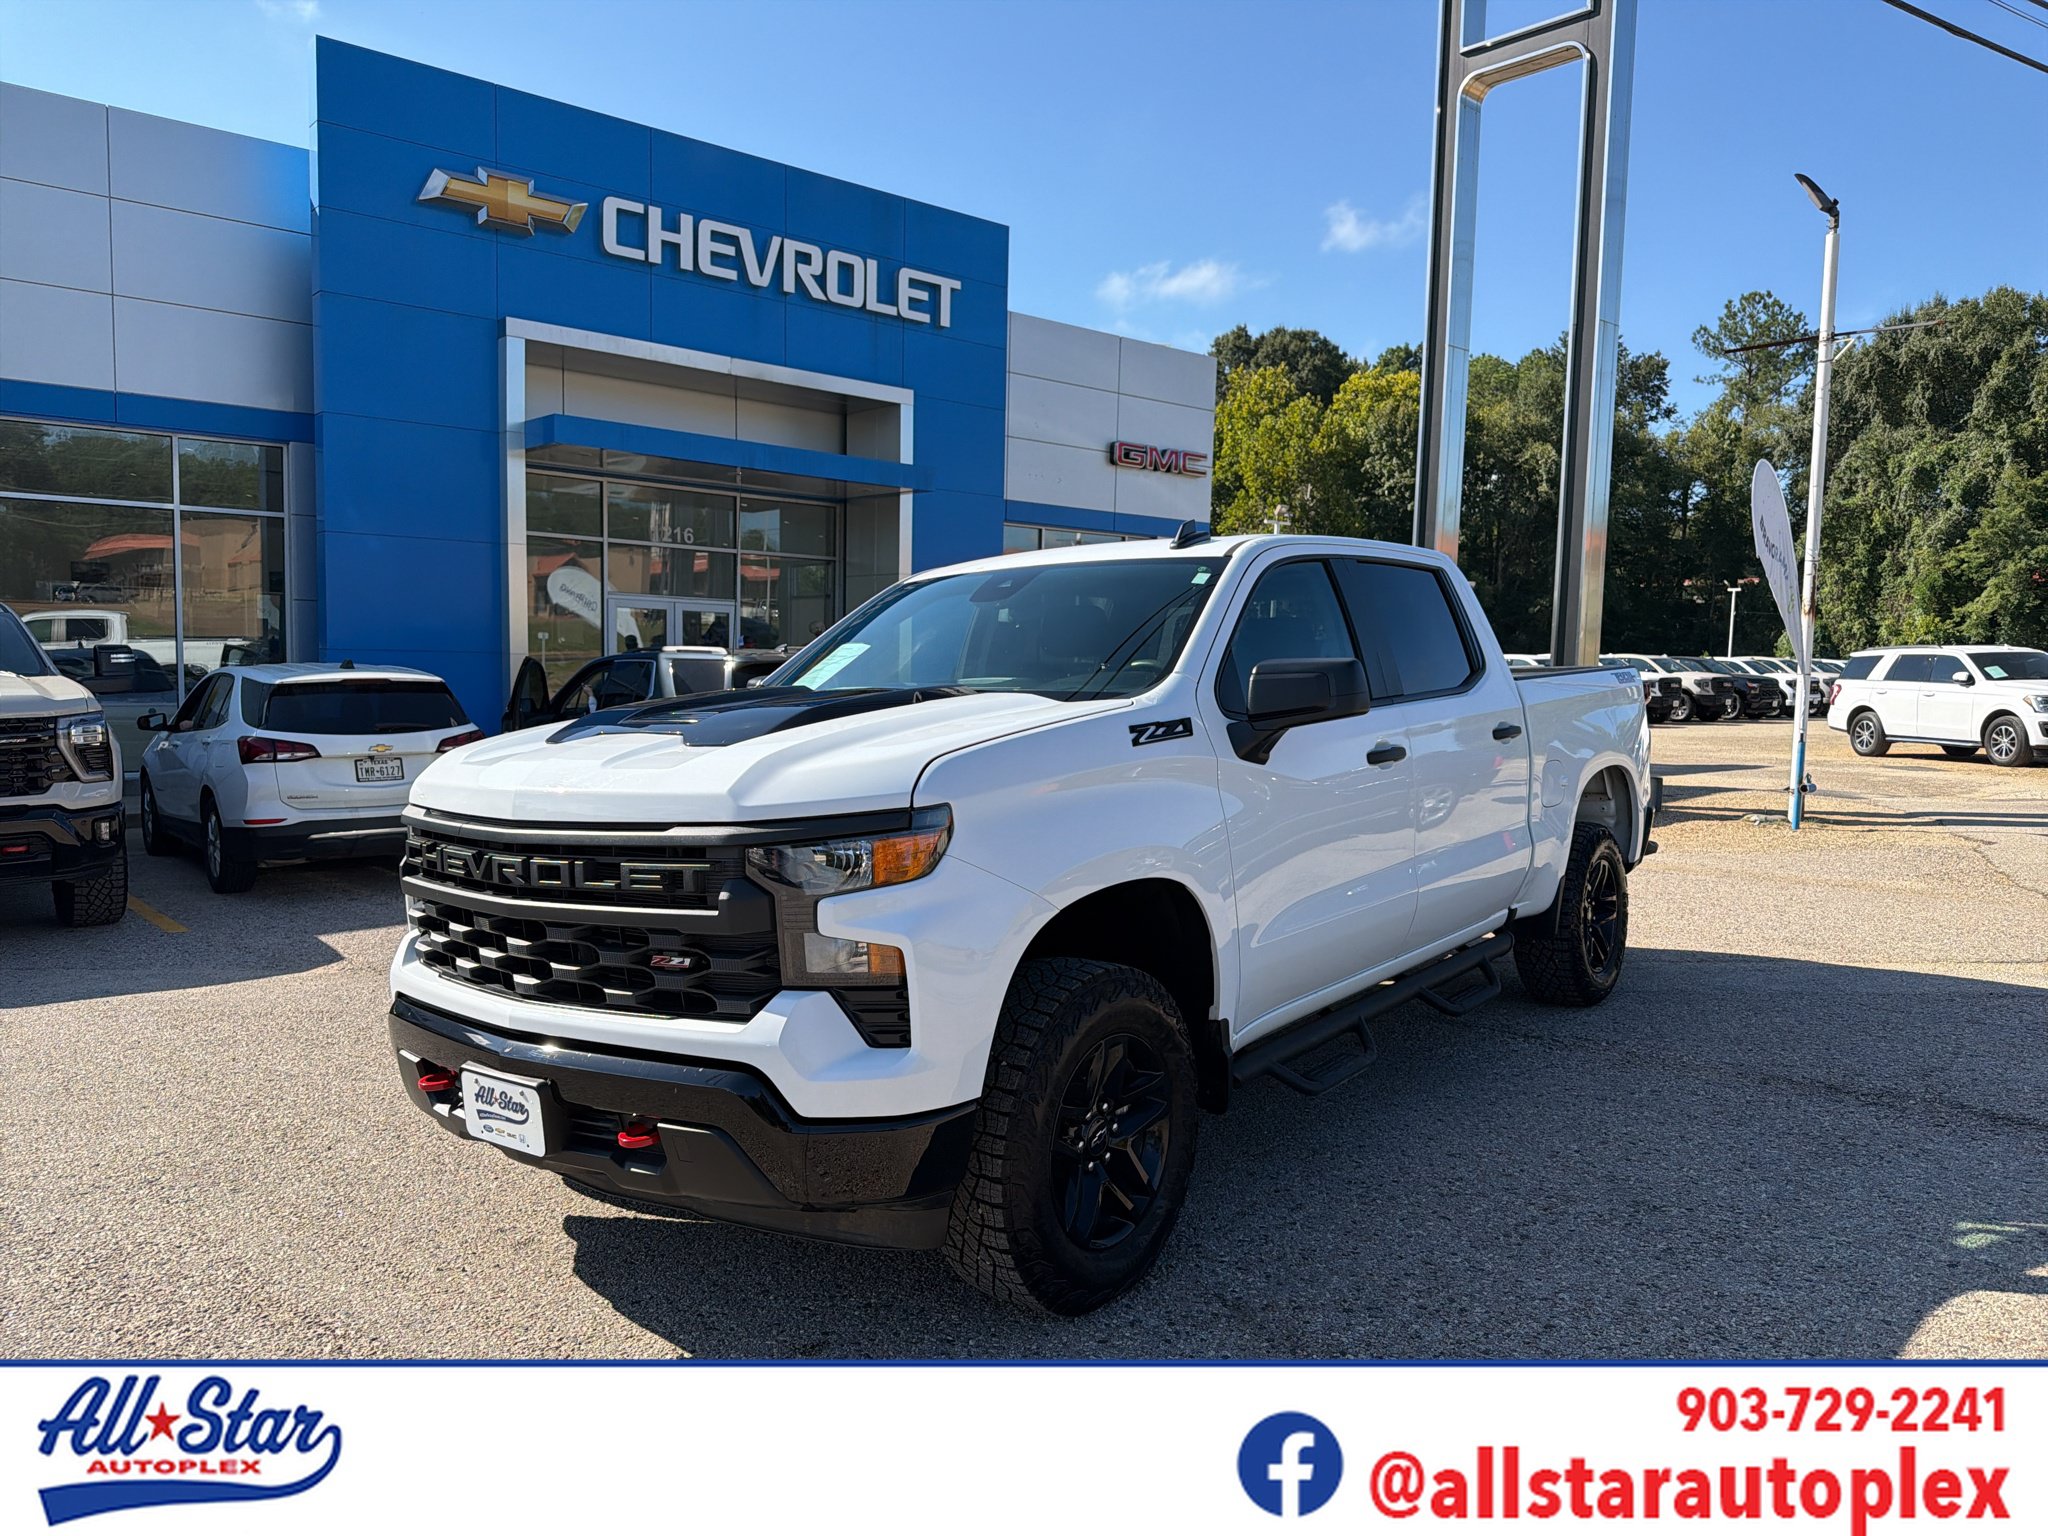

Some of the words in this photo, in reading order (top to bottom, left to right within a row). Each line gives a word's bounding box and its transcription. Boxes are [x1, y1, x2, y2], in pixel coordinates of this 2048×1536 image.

[602, 196, 962, 328] CHEVROLET
[1111, 441, 1208, 478] GMC
[1128, 716, 1193, 747] Z71
[405, 838, 714, 893] CHEVROLET
[650, 955, 691, 968] Z71
[474, 1085, 496, 1107] All
[498, 1090, 530, 1116] Star
